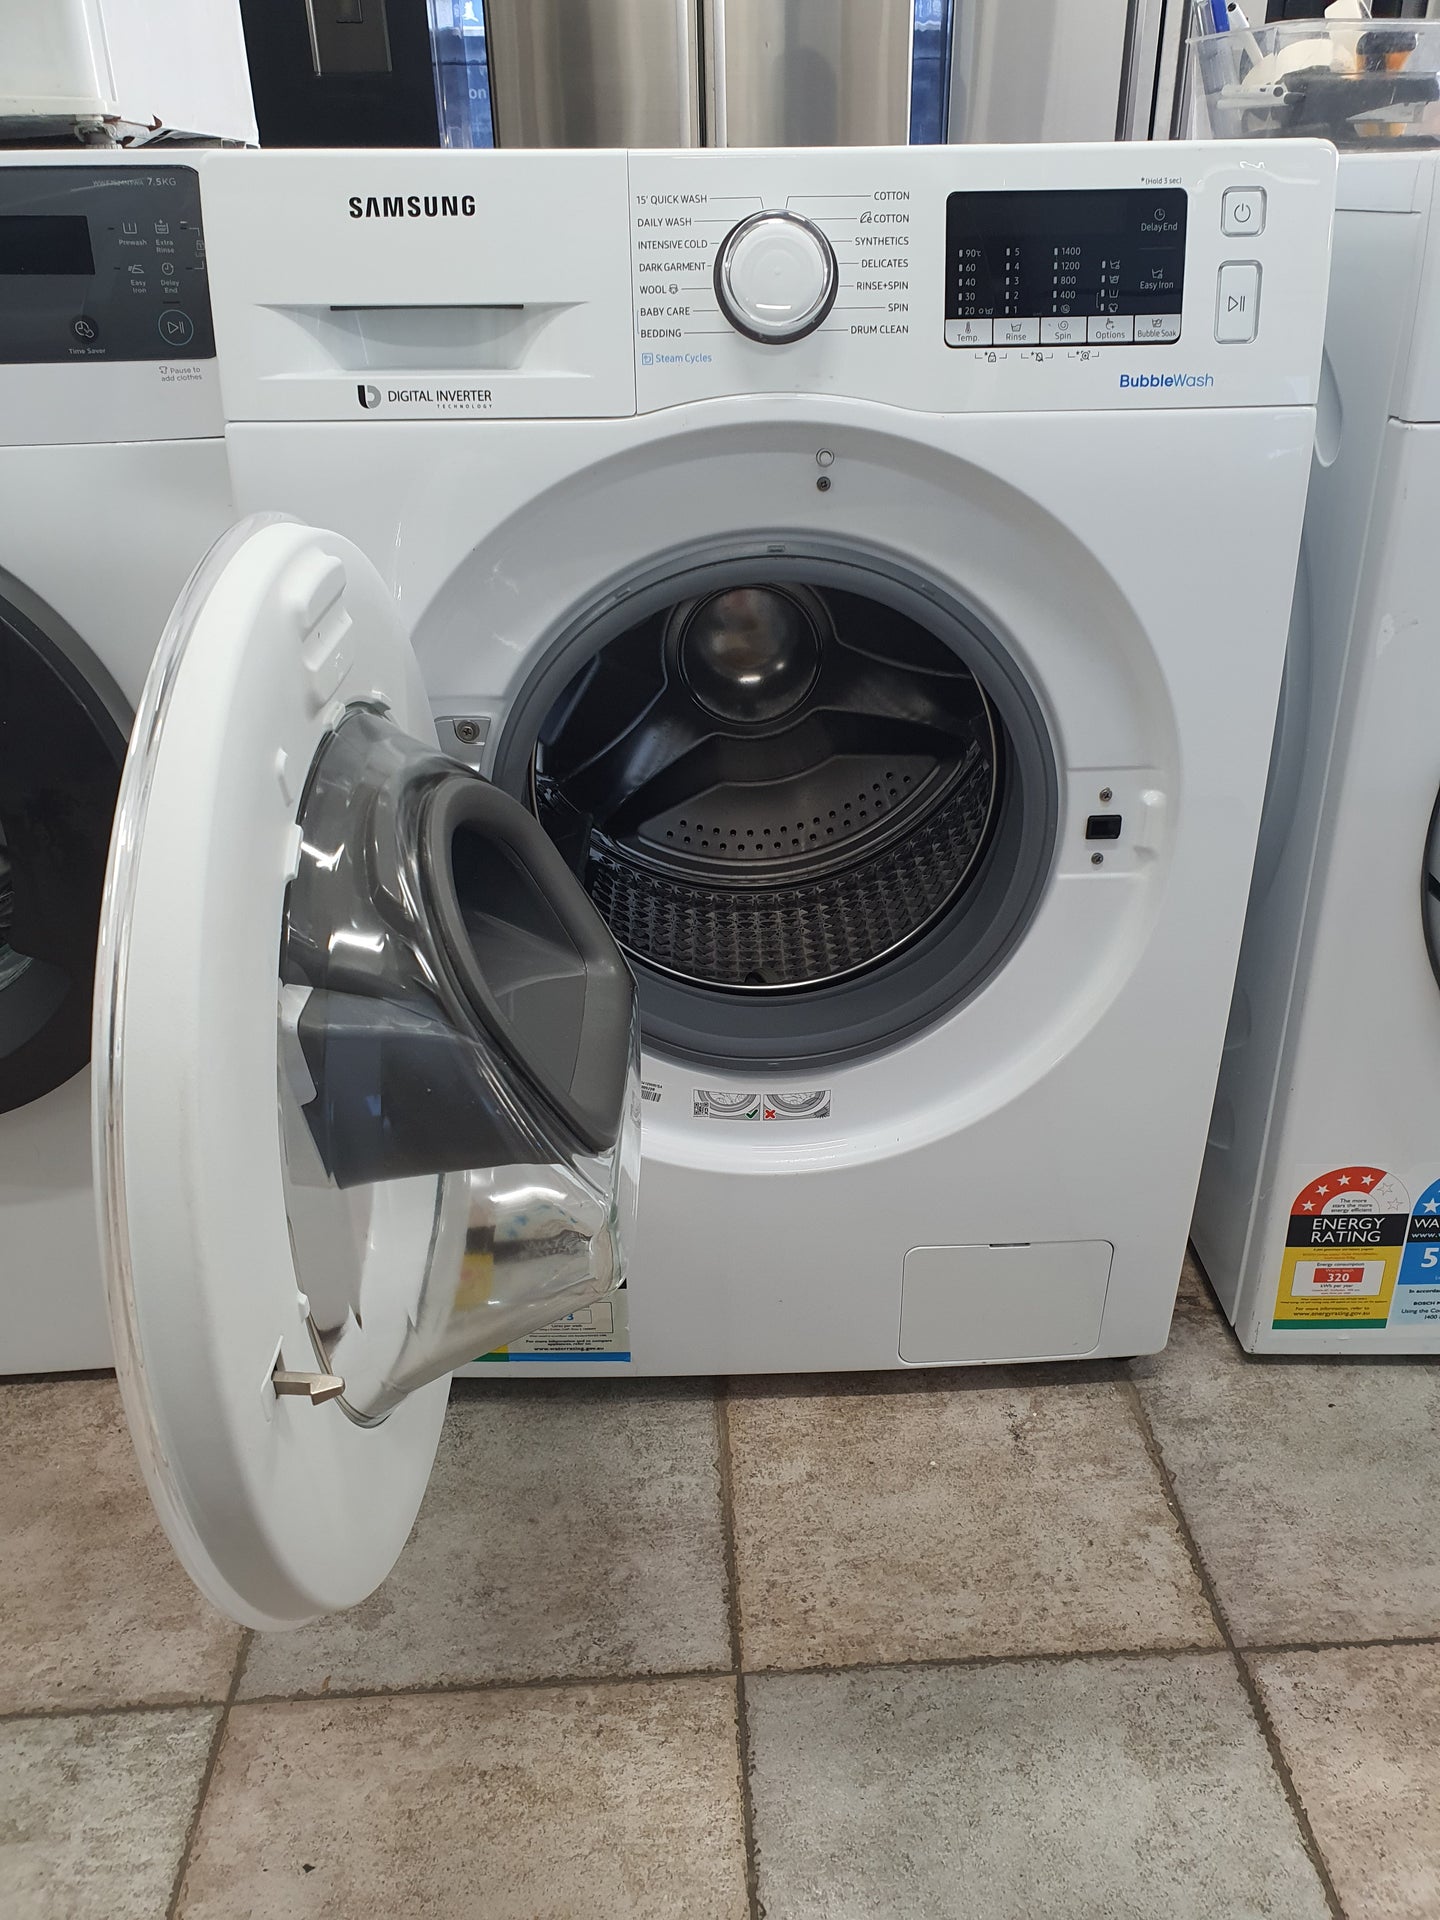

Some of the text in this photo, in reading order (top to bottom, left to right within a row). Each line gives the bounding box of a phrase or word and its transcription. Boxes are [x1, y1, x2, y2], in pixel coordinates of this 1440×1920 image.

[147, 178, 177, 186] 7.5KG
[650, 195, 679, 205] QUICK
[681, 194, 708, 204] WASH
[873, 190, 910, 201] COTTON
[349, 195, 476, 218] SAMSUNG
[637, 216, 692, 227] DAILY WASH
[873, 213, 910, 224] COTTON
[1141, 222, 1178, 232] Delay End
[638, 239, 708, 250] INTENSIVE COLD
[855, 236, 909, 246] SYNTHETICS
[1014, 248, 1020, 256] 5
[1061, 247, 1081, 256] 1400
[639, 261, 706, 272] DARK GARMENT
[861, 258, 909, 268] DELICATES
[965, 263, 976, 272] 60
[1014, 262, 1020, 271] 4
[1061, 261, 1080, 270] 1200
[160, 279, 180, 288] Delay
[856, 280, 909, 290] RINSE+SPIN
[965, 277, 976, 286] 40
[1014, 277, 1020, 285] 3
[1060, 276, 1076, 285] 800
[1140, 280, 1174, 290] Easy Iron
[639, 284, 667, 294] WOOL
[965, 292, 976, 301] 30
[1014, 291, 1019, 300] 2
[1060, 290, 1076, 299] 400
[640, 306, 690, 316] BABY CARE
[888, 303, 909, 313] SPIN
[964, 306, 975, 315] 20
[1013, 305, 1018, 314] 1
[640, 328, 682, 338] BEDDING
[850, 325, 909, 335] DRUM CLEAN
[1137, 328, 1177, 338] Bubble Soak
[957, 333, 980, 343] Temp.
[1006, 332, 1027, 341] Rinse
[1055, 331, 1072, 342] Spin
[1096, 330, 1125, 341] Options
[655, 353, 712, 364] Steam Cycles
[161, 373, 202, 383] add clothes
[1119, 373, 1214, 388] BubbleWash
[388, 390, 492, 402] DIGITAL INVERTER
[1313, 1218, 1385, 1230] ENERGY
[1311, 1231, 1380, 1243] RATING
[1327, 1273, 1350, 1282] 320
